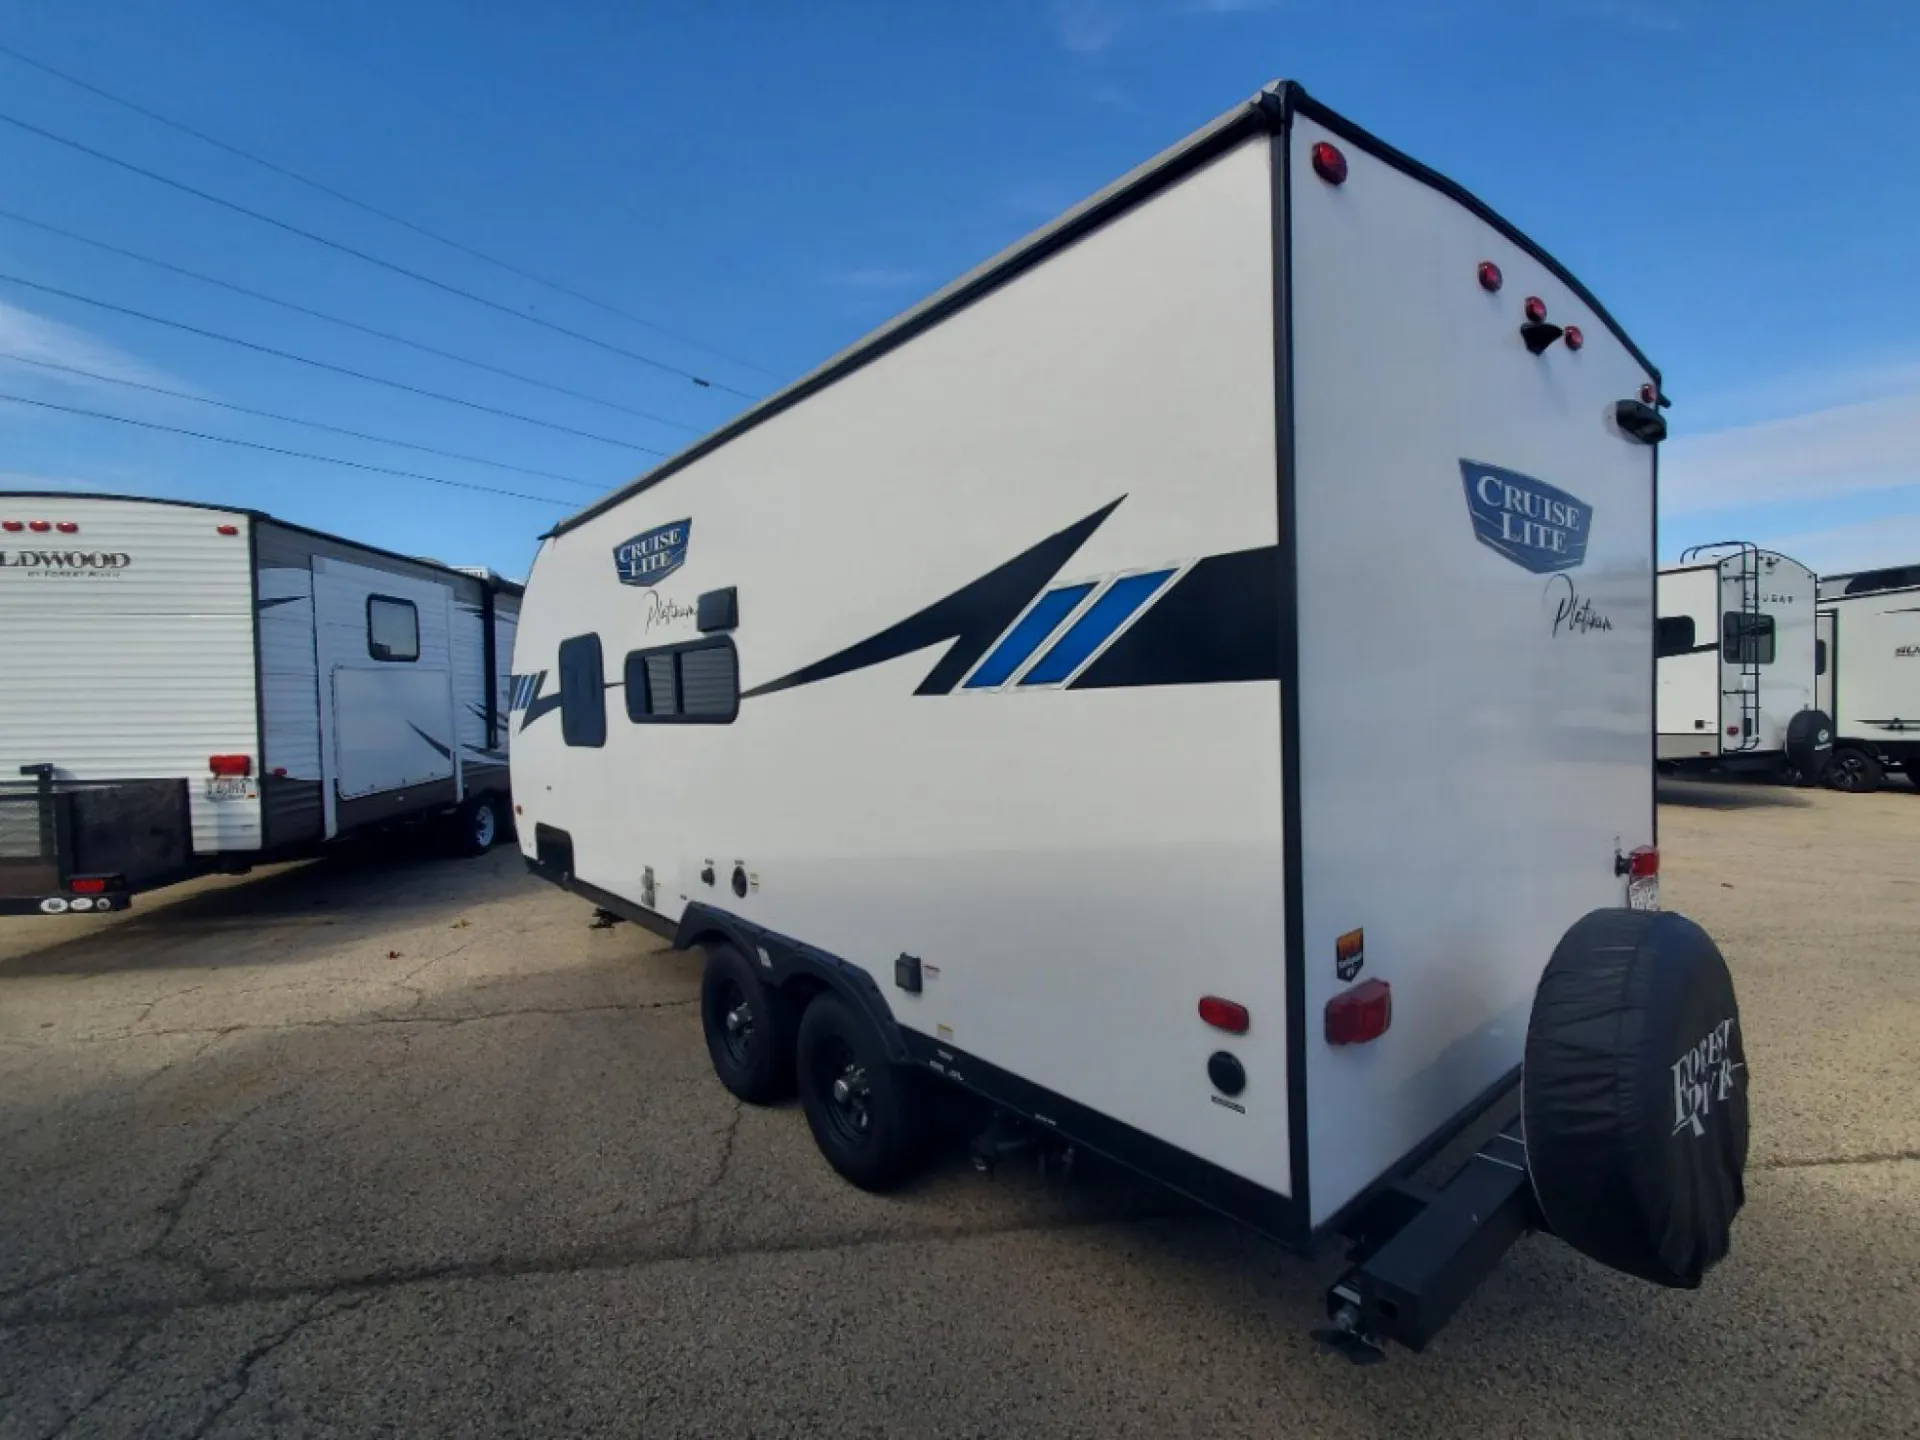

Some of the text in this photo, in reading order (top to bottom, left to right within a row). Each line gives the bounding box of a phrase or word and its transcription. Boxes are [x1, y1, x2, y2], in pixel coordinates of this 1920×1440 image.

[1476, 475, 1580, 531] CRUISE
[619, 528, 681, 563] CRUISE
[1500, 511, 1566, 554] LITE
[631, 550, 671, 577] LITE
